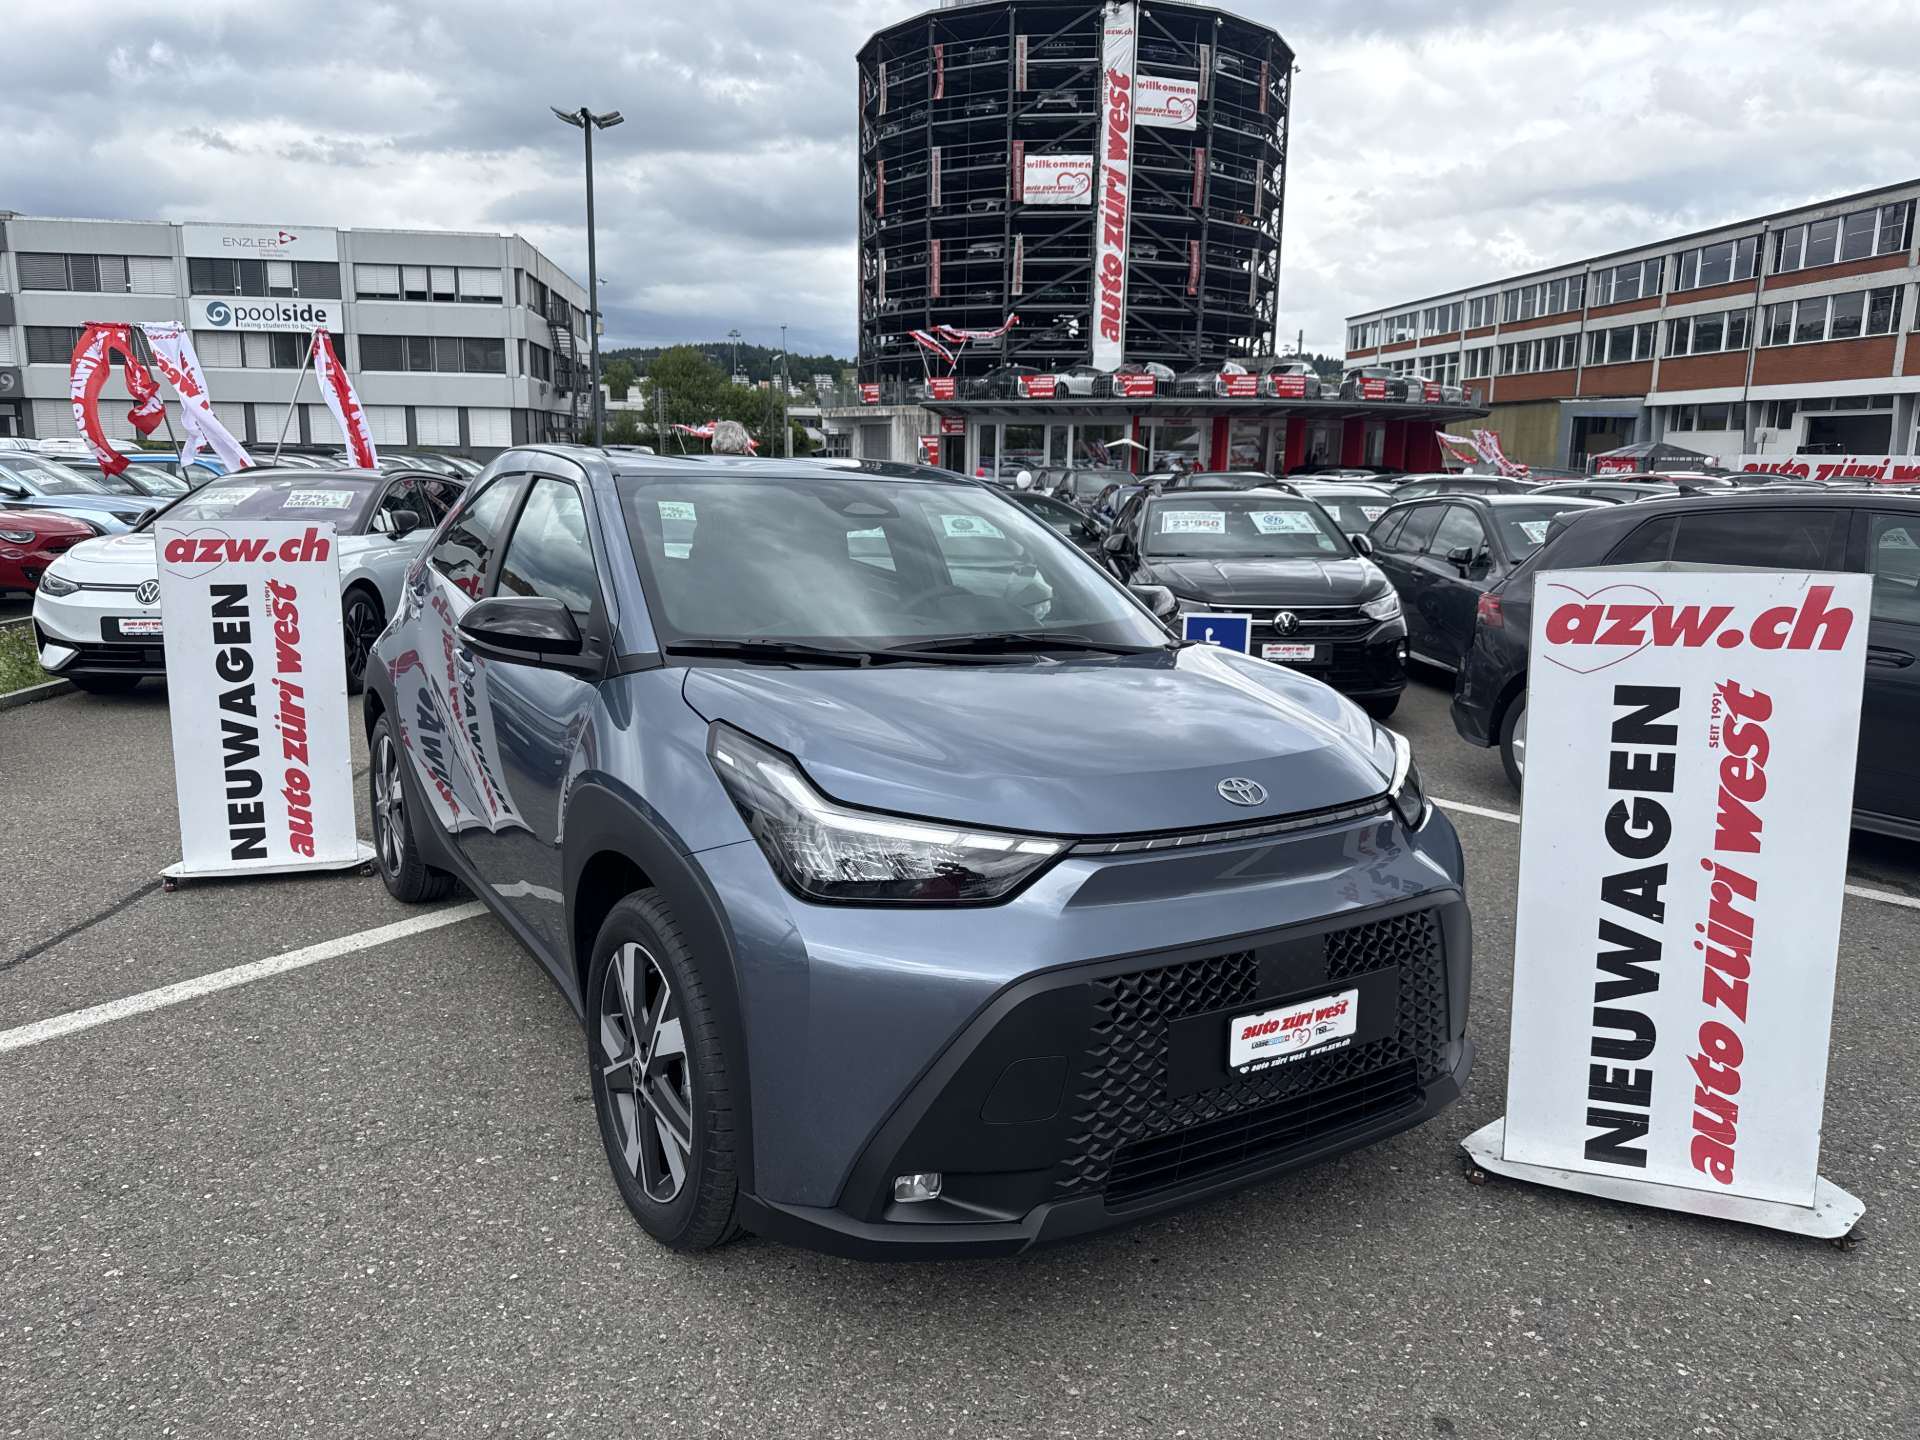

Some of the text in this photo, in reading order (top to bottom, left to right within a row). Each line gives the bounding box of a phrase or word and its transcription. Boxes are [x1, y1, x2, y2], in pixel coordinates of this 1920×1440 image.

[1137, 81, 1196, 95] willkommen
[1026, 160, 1091, 169] willkommen
[1098, 68, 1130, 343] auto züri west
[222, 237, 278, 248] ENZLER
[234, 302, 327, 328] poolside
[164, 527, 330, 563] azw.ch
[1545, 585, 1855, 651] azw.ch
[209, 584, 268, 861] NEUWAGEN
[264, 578, 315, 858] auto züri west
[1709, 692, 1722, 749] SEIT 1991
[1584, 684, 1682, 1169] NEUWAGEN
[1686, 678, 1773, 1186] auto züri west
[1240, 999, 1349, 1041] auto züri west
[1251, 1061, 1270, 1072] auto
[1270, 1056, 1288, 1068] züri
[1288, 1051, 1307, 1063] west
